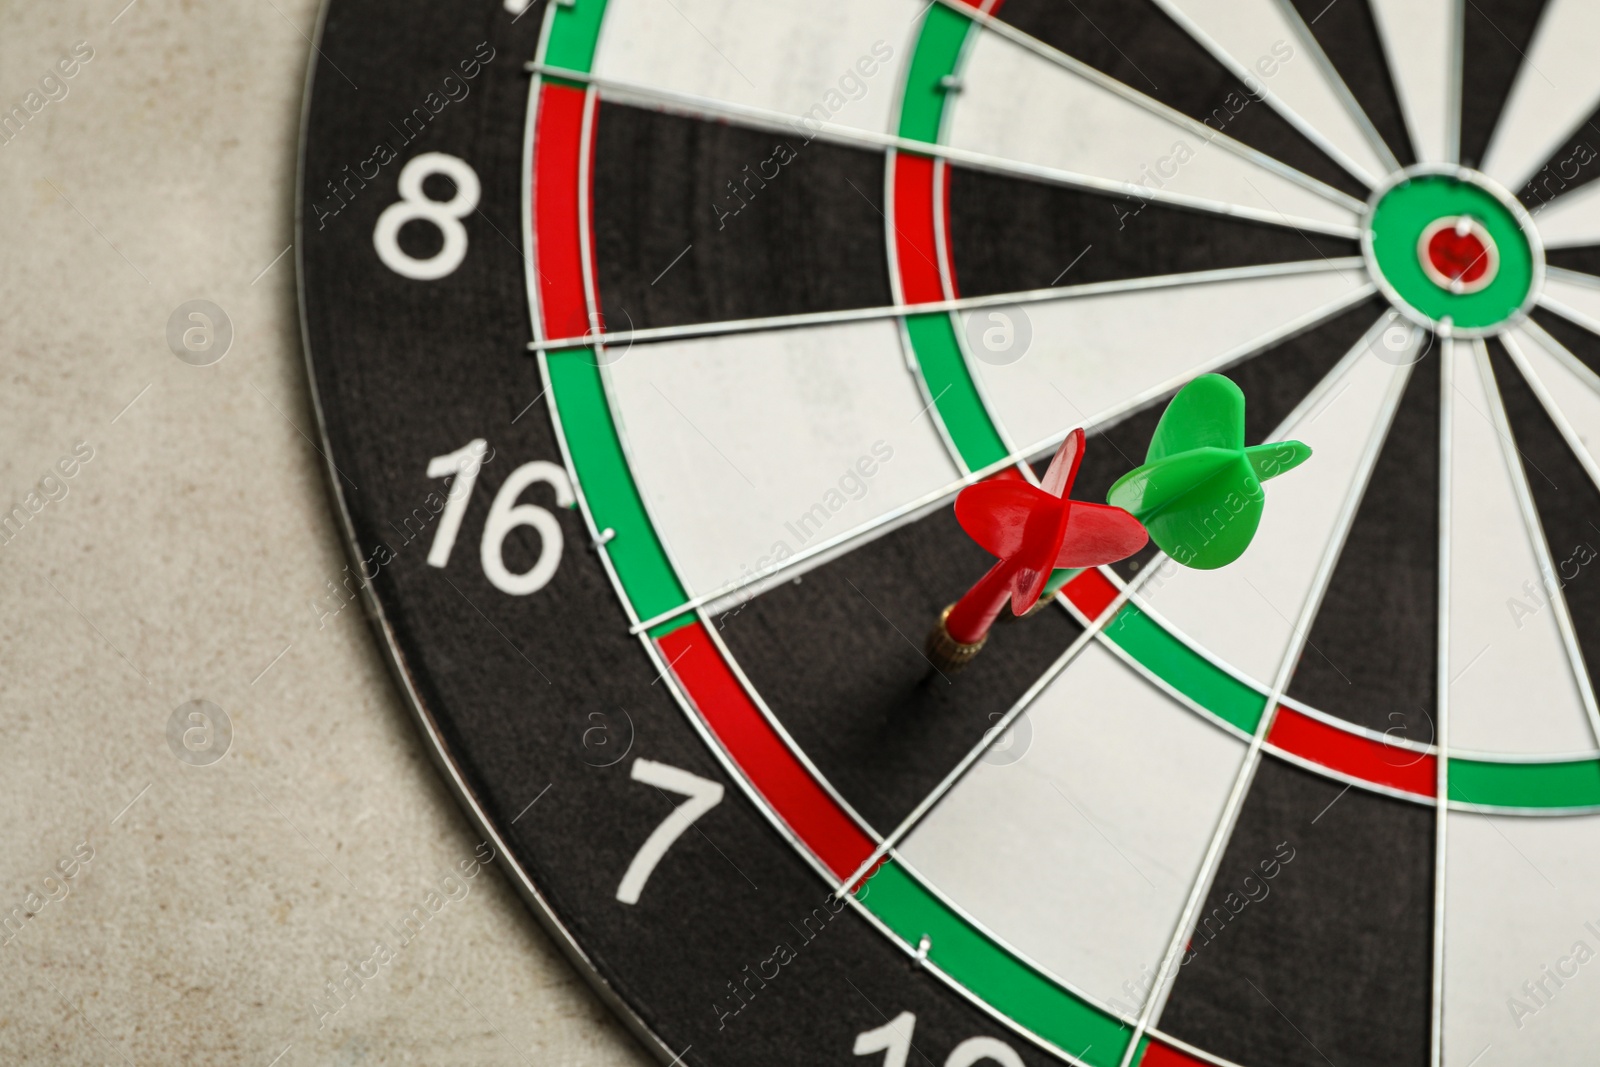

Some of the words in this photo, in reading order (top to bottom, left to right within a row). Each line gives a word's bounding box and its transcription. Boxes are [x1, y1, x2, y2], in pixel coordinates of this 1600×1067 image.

[373, 153, 480, 280] 8
[426, 438, 576, 596] 16
[615, 758, 724, 905] 7
